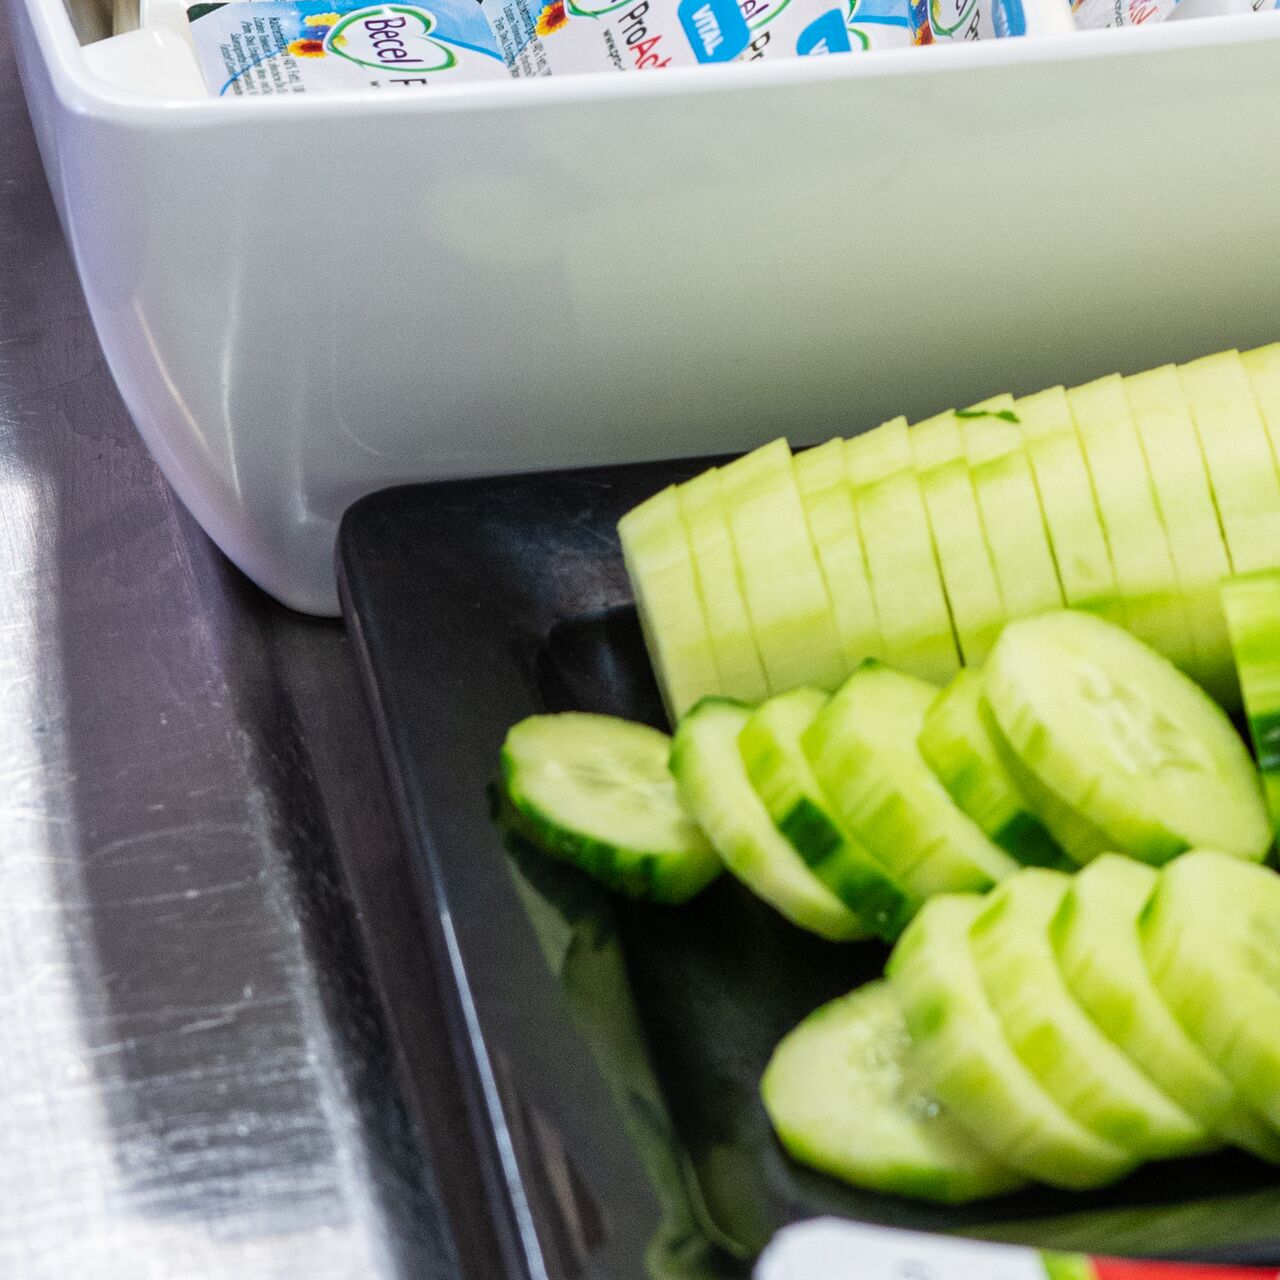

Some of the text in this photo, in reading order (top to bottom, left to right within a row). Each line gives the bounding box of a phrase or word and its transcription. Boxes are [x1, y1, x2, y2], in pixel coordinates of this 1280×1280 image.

[363, 15, 424, 64] Becel
[617, 0, 673, 71] ProAc
[690, 3, 725, 57] VITAL
